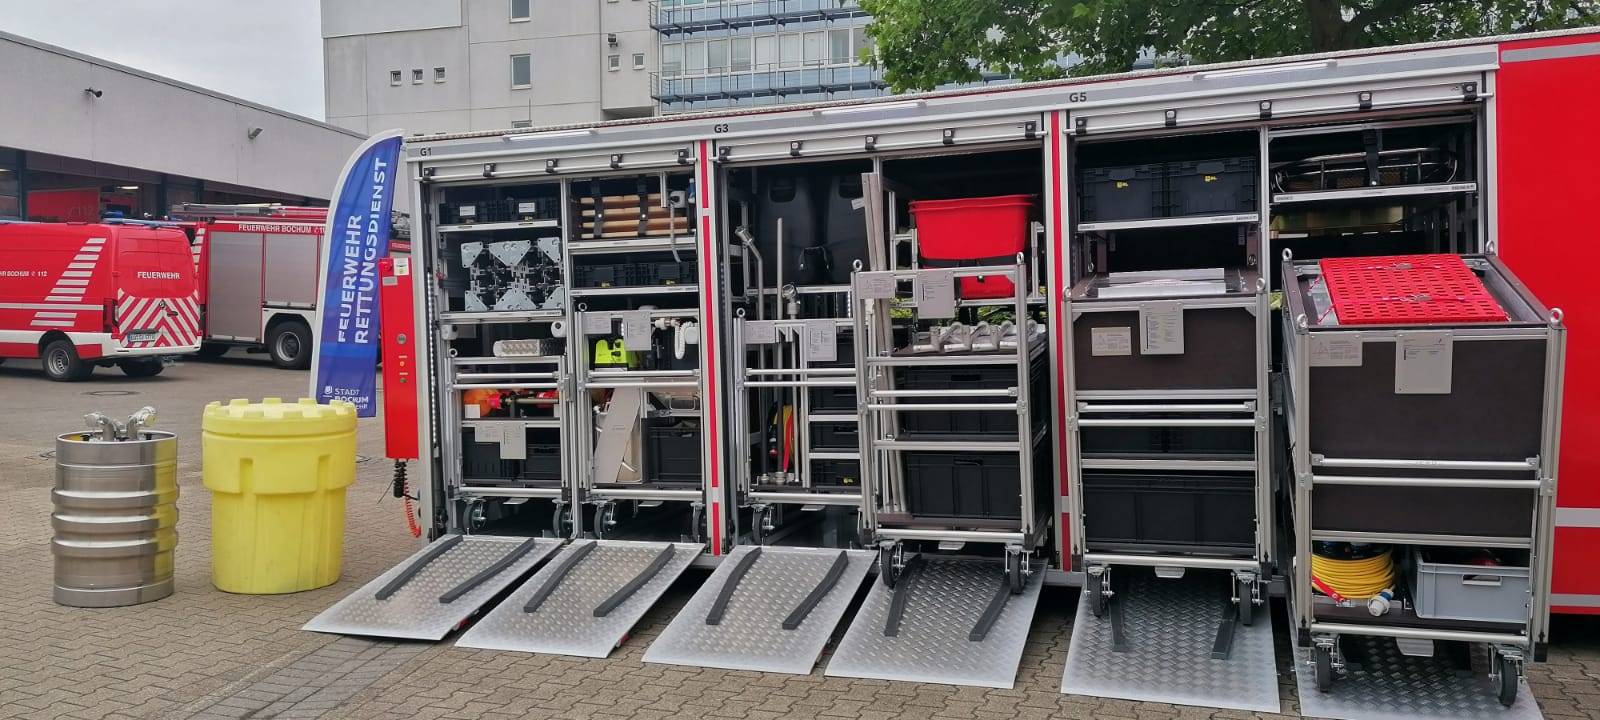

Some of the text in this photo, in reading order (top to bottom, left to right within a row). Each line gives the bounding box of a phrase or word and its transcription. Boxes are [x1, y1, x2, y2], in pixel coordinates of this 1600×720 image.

[1069, 92, 1087, 103] G5
[714, 123, 729, 134] G3
[419, 147, 432, 157] G1
[238, 224, 280, 233] FEUERWEHR
[281, 226, 312, 235] BOCHUM
[354, 157, 388, 344] RETTUNGSDIENST
[137, 271, 181, 280] FEUERWEHR
[338, 215, 362, 343] FEUERWEHR
